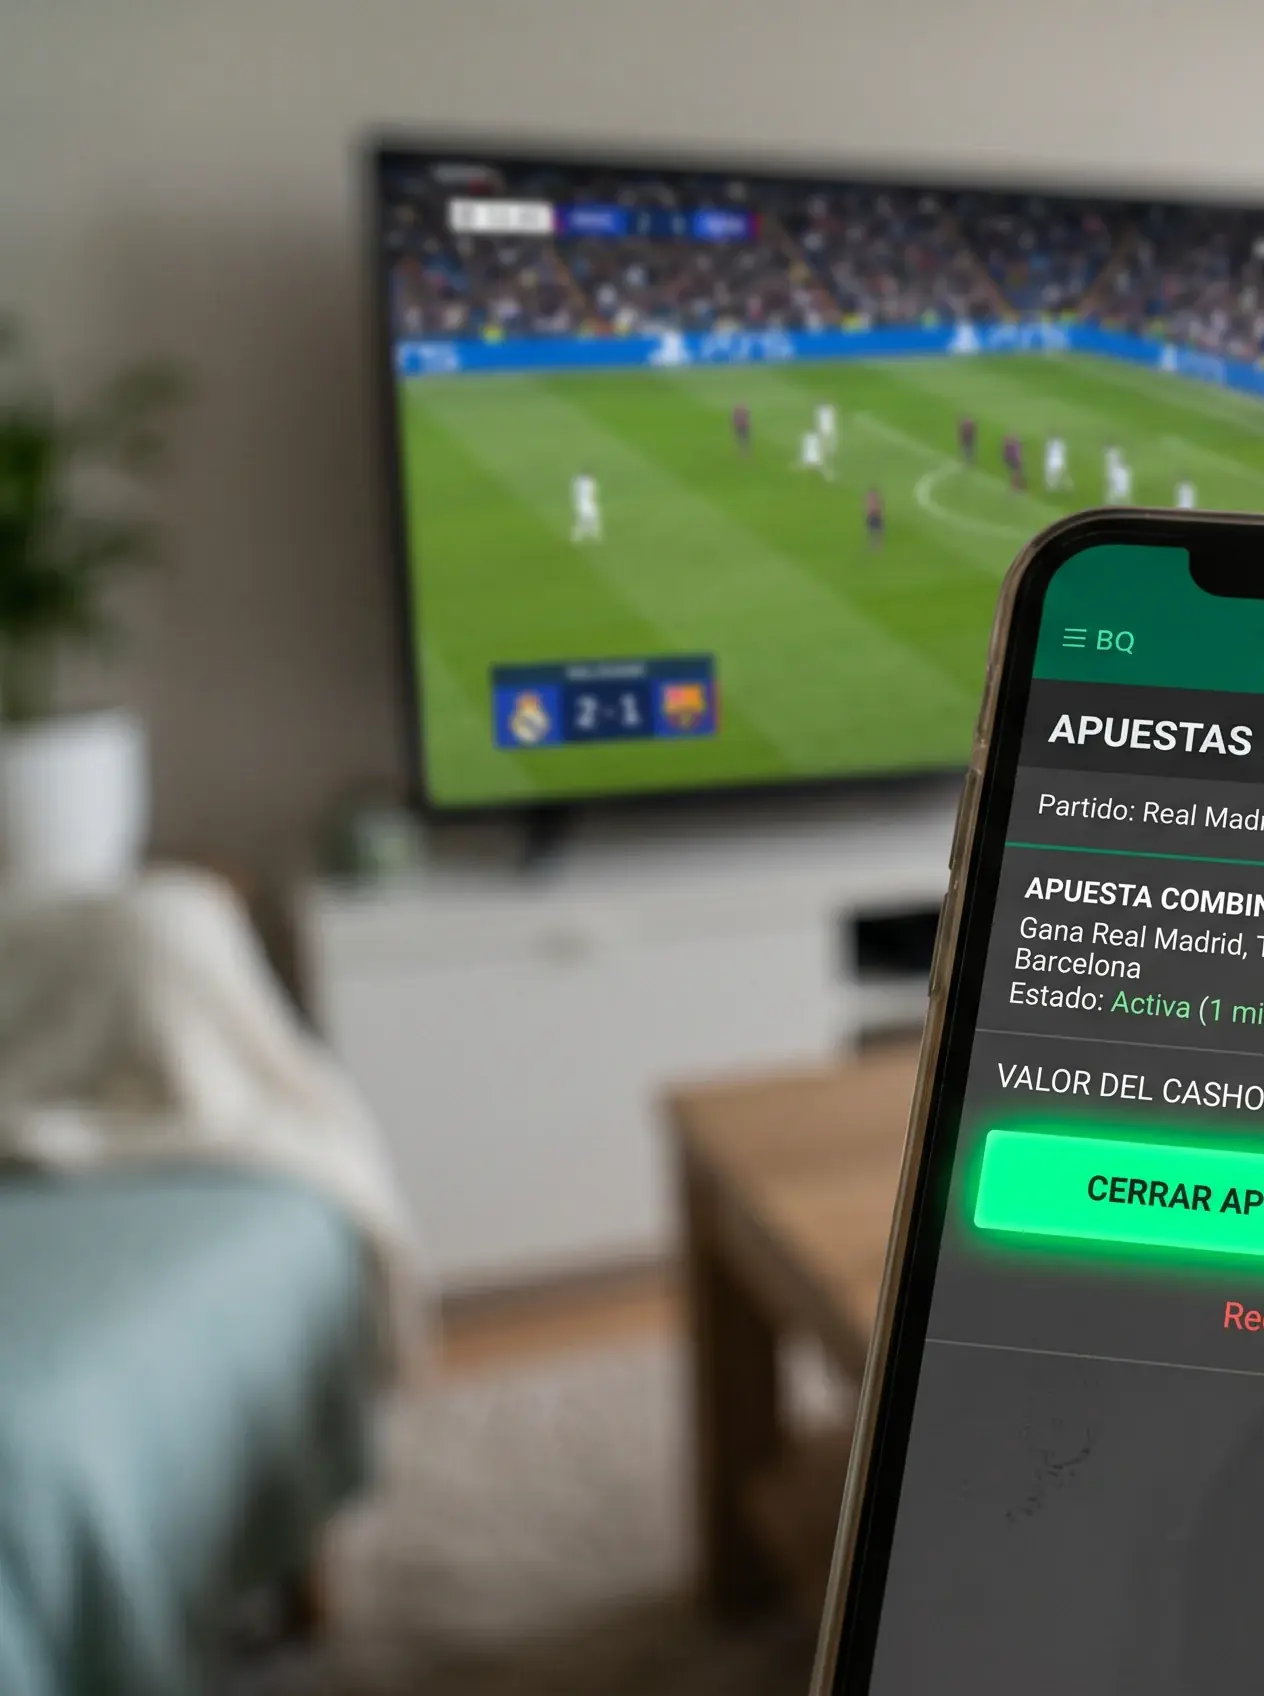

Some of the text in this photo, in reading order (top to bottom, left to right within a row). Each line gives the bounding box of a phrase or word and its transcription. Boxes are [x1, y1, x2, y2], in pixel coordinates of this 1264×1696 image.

[1096, 629, 1135, 655] BQ
[1047, 714, 1253, 756] APUESTAS
[1038, 793, 1135, 822] Partido:
[1143, 801, 1197, 826] Real
[1024, 876, 1153, 909] APUESTA
[1020, 916, 1084, 943] Gana
[1092, 921, 1147, 948] Real
[1154, 927, 1248, 960] Madrid,
[1014, 947, 1141, 979] Barcelona
[1009, 981, 1104, 1011] Estado:
[1110, 990, 1191, 1019] Activa
[1199, 995, 1221, 1027] (1
[997, 1062, 1091, 1096] VALOR
[1099, 1072, 1153, 1101] DEL
[1087, 1174, 1212, 1212] CERRAR
